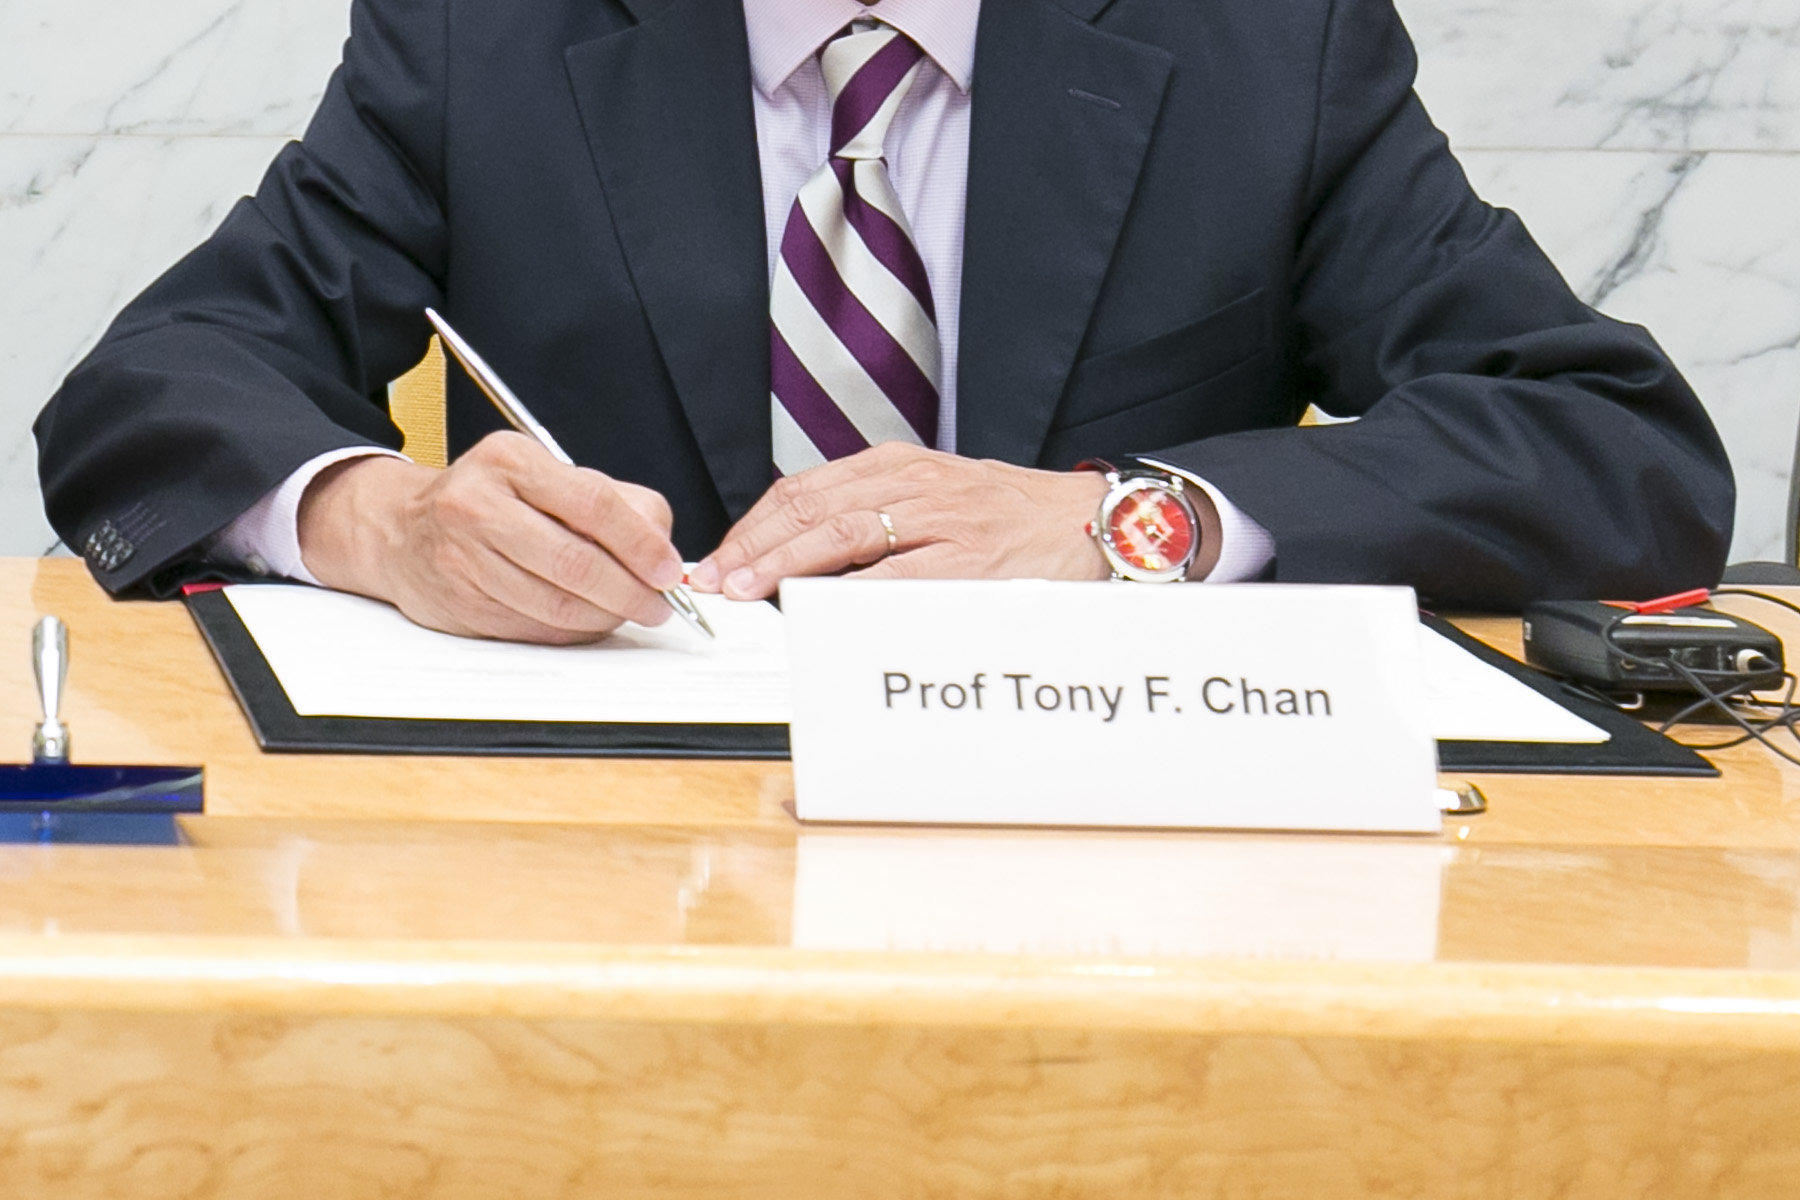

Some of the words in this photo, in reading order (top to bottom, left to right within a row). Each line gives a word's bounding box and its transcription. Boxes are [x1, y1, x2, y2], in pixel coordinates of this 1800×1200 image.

[882, 670, 987, 710] Prof
[1002, 672, 1124, 723] Tony
[1143, 674, 1182, 714] F.
[1200, 675, 1332, 717] Chan
